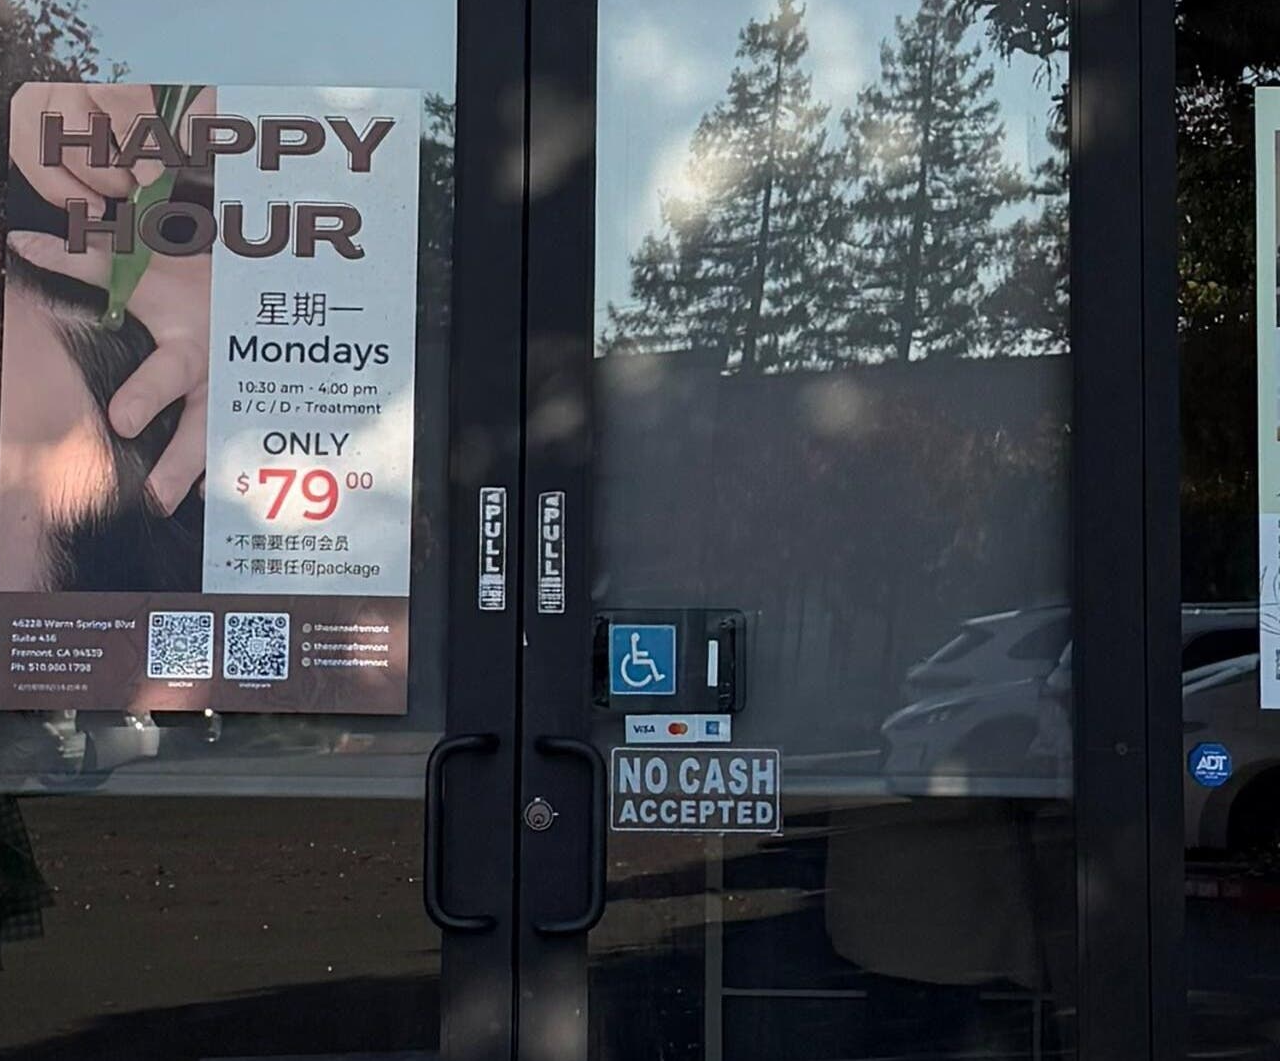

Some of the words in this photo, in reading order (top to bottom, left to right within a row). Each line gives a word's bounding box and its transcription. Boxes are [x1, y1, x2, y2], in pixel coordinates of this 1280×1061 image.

[40, 111, 396, 172] HAPPY
[65, 198, 366, 259] HOUR
[256, 292, 364, 326] 星期一
[228, 335, 390, 371] Mondays
[238, 381, 276, 394] 10:30
[280, 384, 304, 394] am
[353, 385, 378, 397] pm
[232, 401, 242, 413] B
[246, 401, 252, 413] /
[255, 401, 266, 413] C
[270, 401, 276, 413] /
[280, 401, 292, 413] D
[305, 402, 382, 414] Treatment
[263, 432, 350, 456] ONLY
[236, 472, 250, 495] $
[258, 468, 340, 521] 79
[346, 472, 373, 489] 00
[484, 504, 501, 572] PULL
[542, 507, 560, 576] PULL
[44, 619, 74, 628] Warm
[76, 619, 112, 630] Springs
[115, 619, 136, 628] Blvd
[11, 634, 37, 642] Suite
[56, 648, 71, 657] CA
[633, 725, 656, 734] VISA
[1196, 755, 1227, 771] ADT
[619, 757, 668, 795] NO
[678, 757, 774, 795] CASH
[618, 799, 773, 824] ACCEPTED
